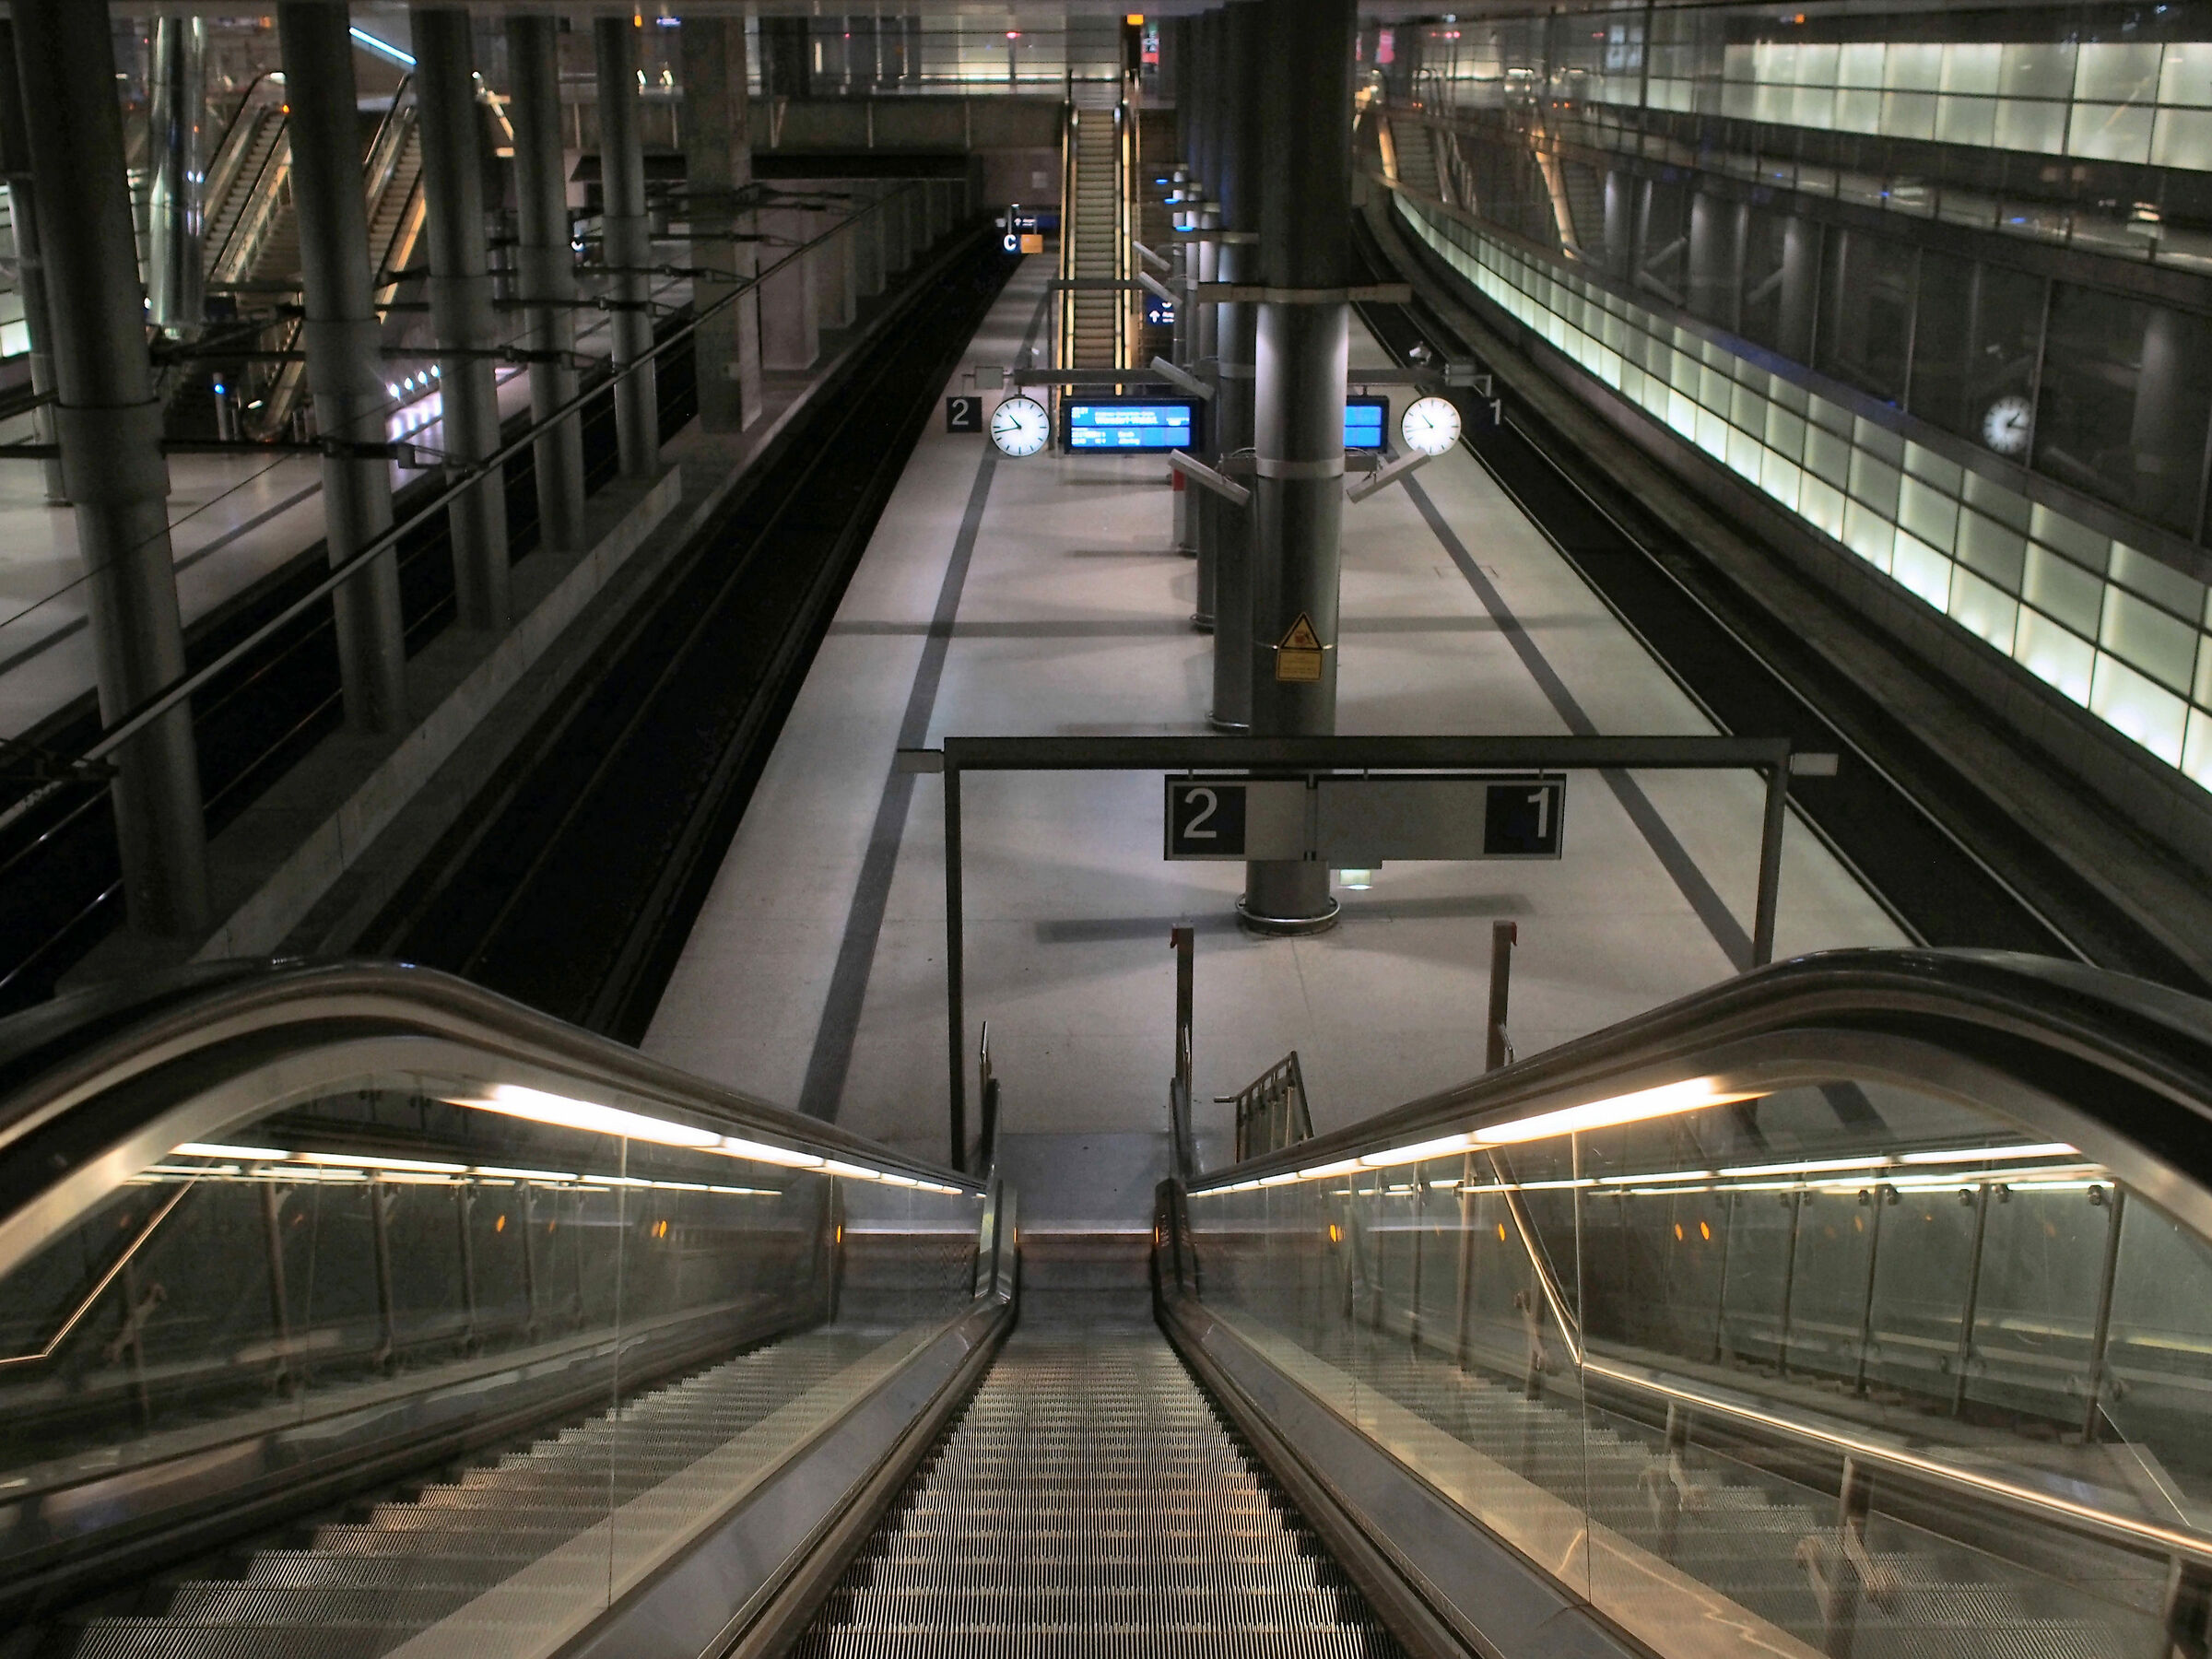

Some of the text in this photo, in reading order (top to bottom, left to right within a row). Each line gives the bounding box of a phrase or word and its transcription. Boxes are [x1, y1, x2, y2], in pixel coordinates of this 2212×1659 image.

[1004, 234, 1017, 251] C
[952, 399, 969, 425] 2
[1489, 398, 1501, 426] 1
[1183, 788, 1218, 839] 2
[1527, 787, 1549, 838] 1
